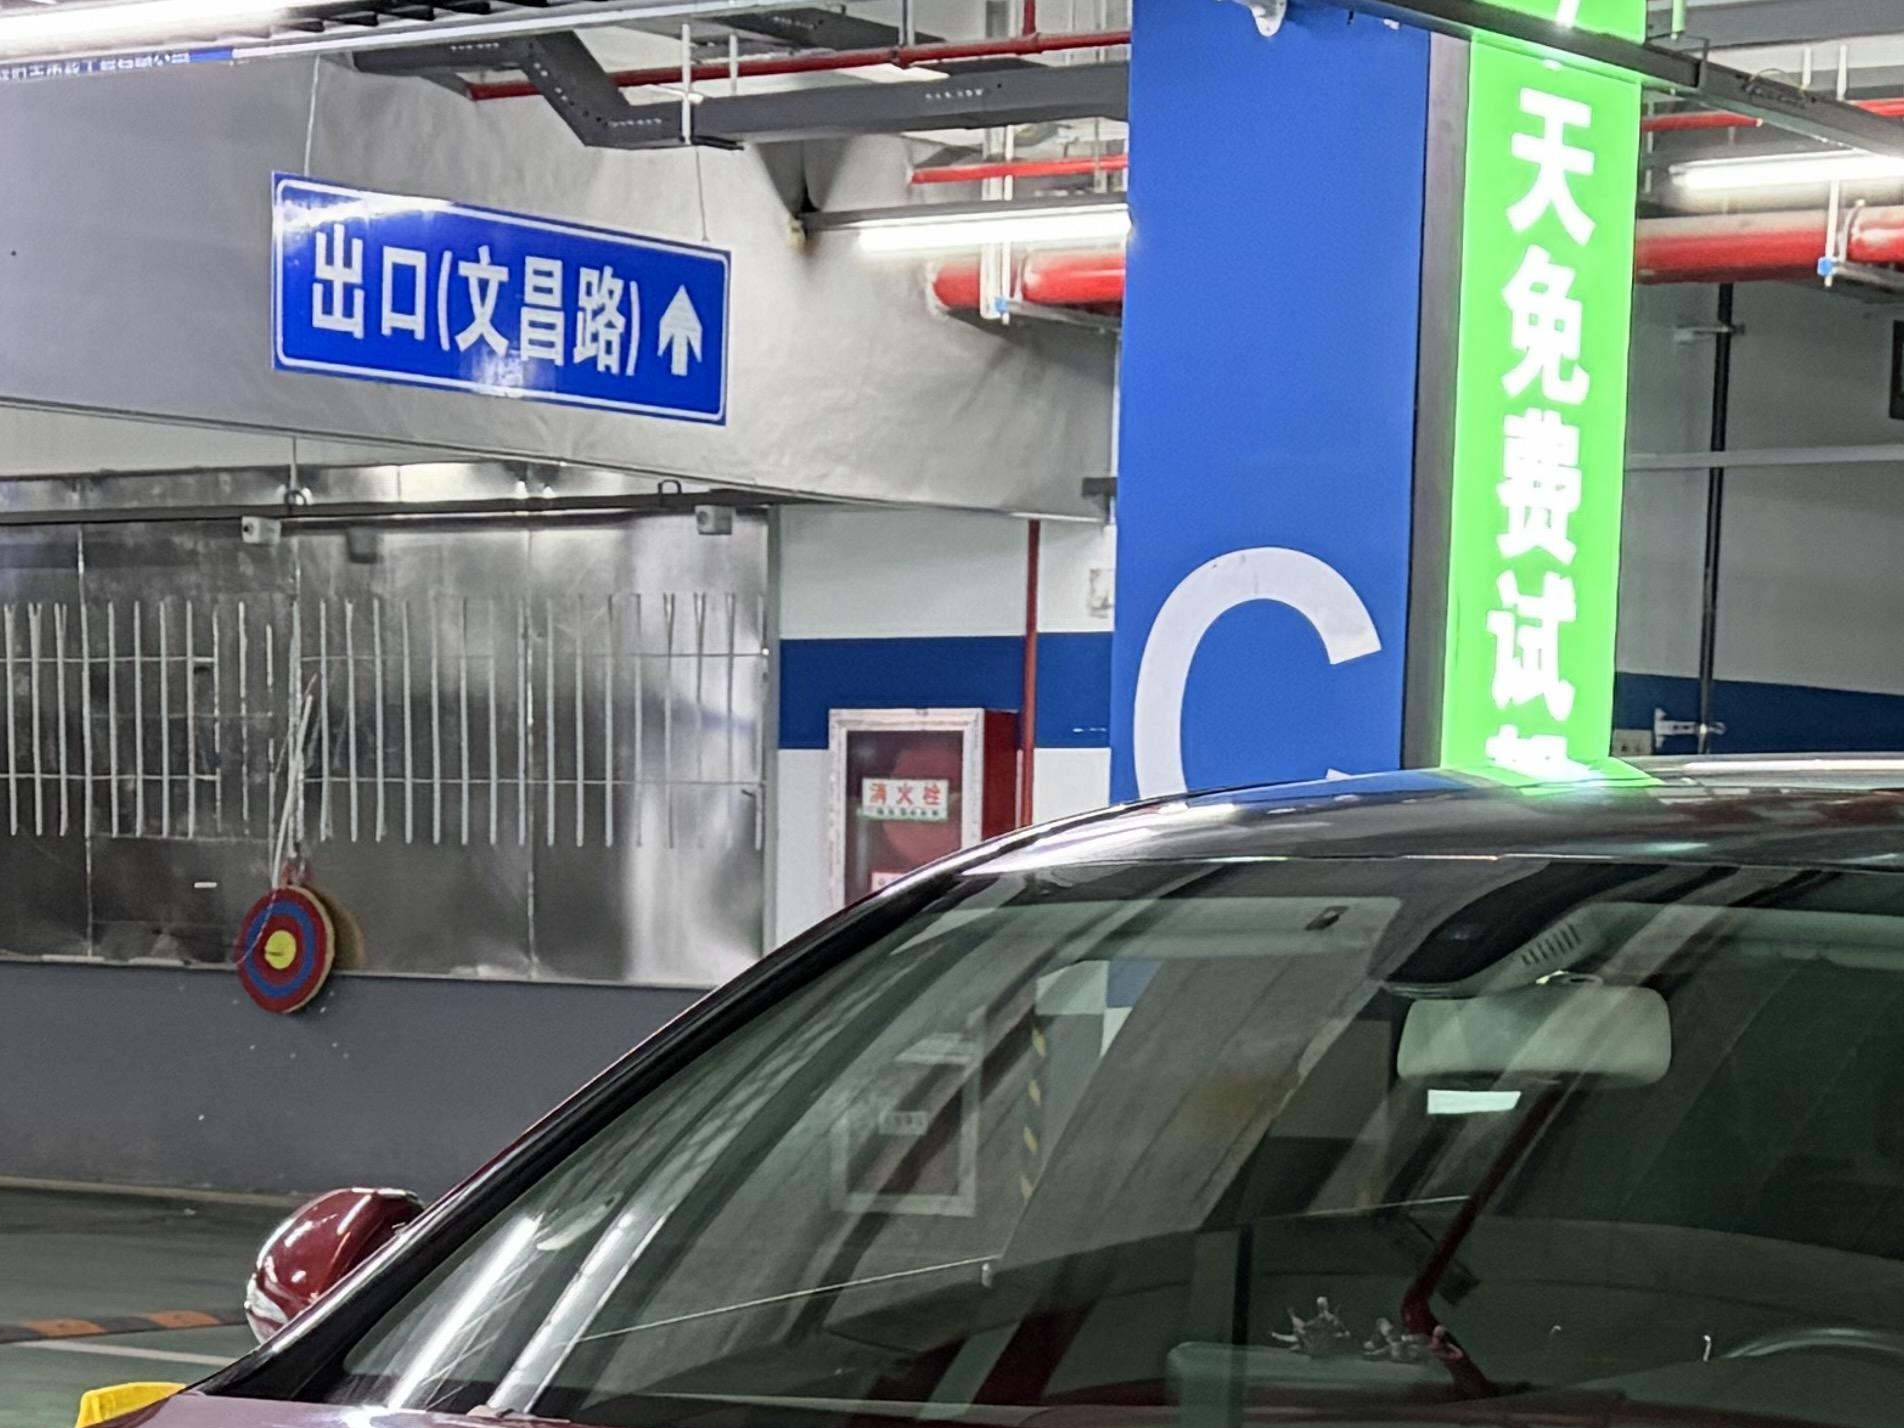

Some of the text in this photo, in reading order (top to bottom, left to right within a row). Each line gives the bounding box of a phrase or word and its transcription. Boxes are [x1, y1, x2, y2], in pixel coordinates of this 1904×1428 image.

[312, 223, 640, 376] 出口(文昌路)
[1485, 0, 1596, 778] 天免费试
[1133, 546, 1382, 803] C
